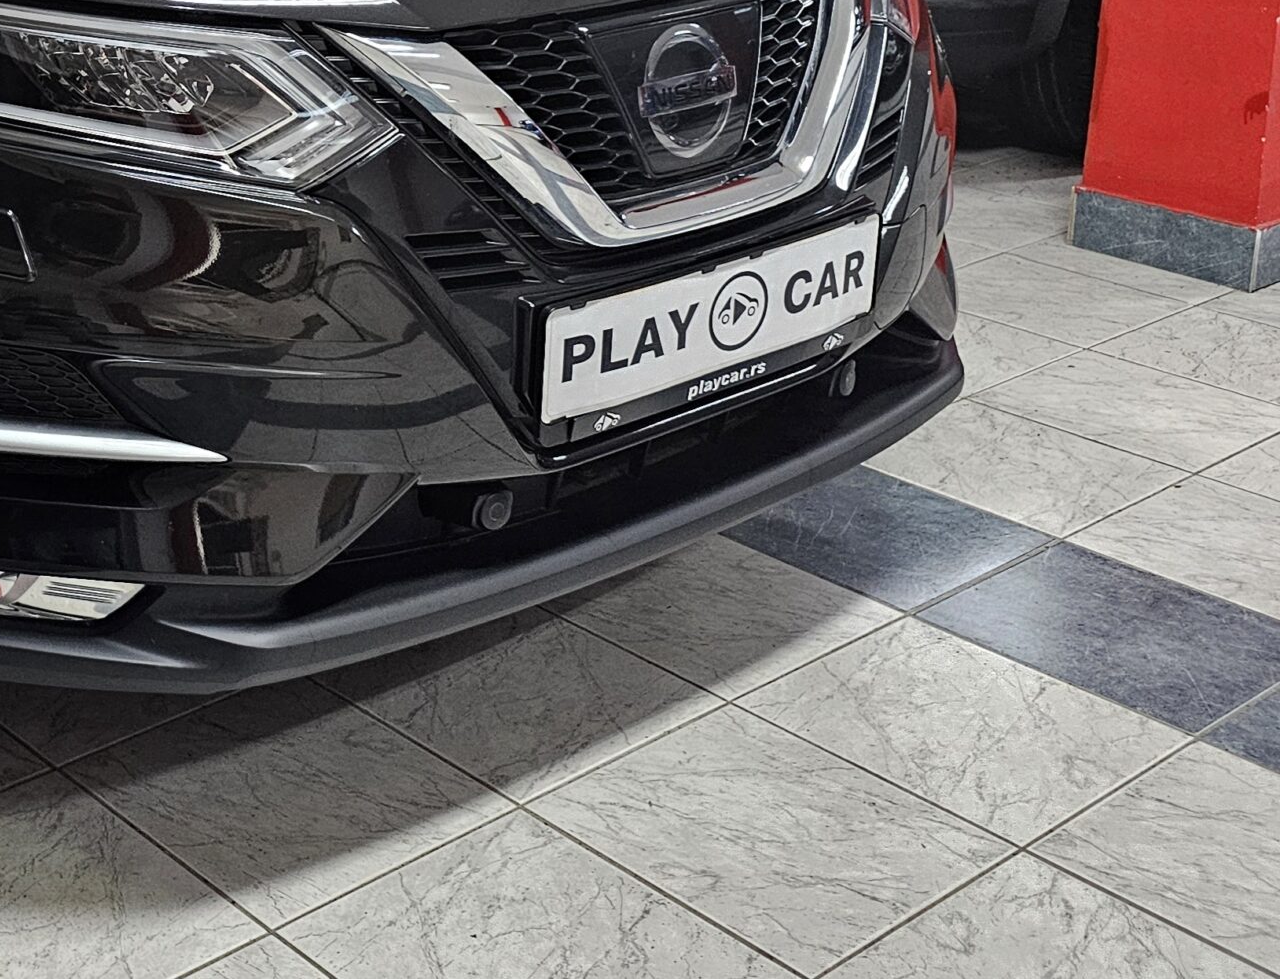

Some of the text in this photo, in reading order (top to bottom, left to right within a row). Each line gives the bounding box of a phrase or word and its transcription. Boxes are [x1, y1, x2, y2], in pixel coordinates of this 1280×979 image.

[654, 72, 734, 107] NISSAN
[561, 250, 865, 384] PLAY CAR
[687, 361, 766, 400] playcar.rs
